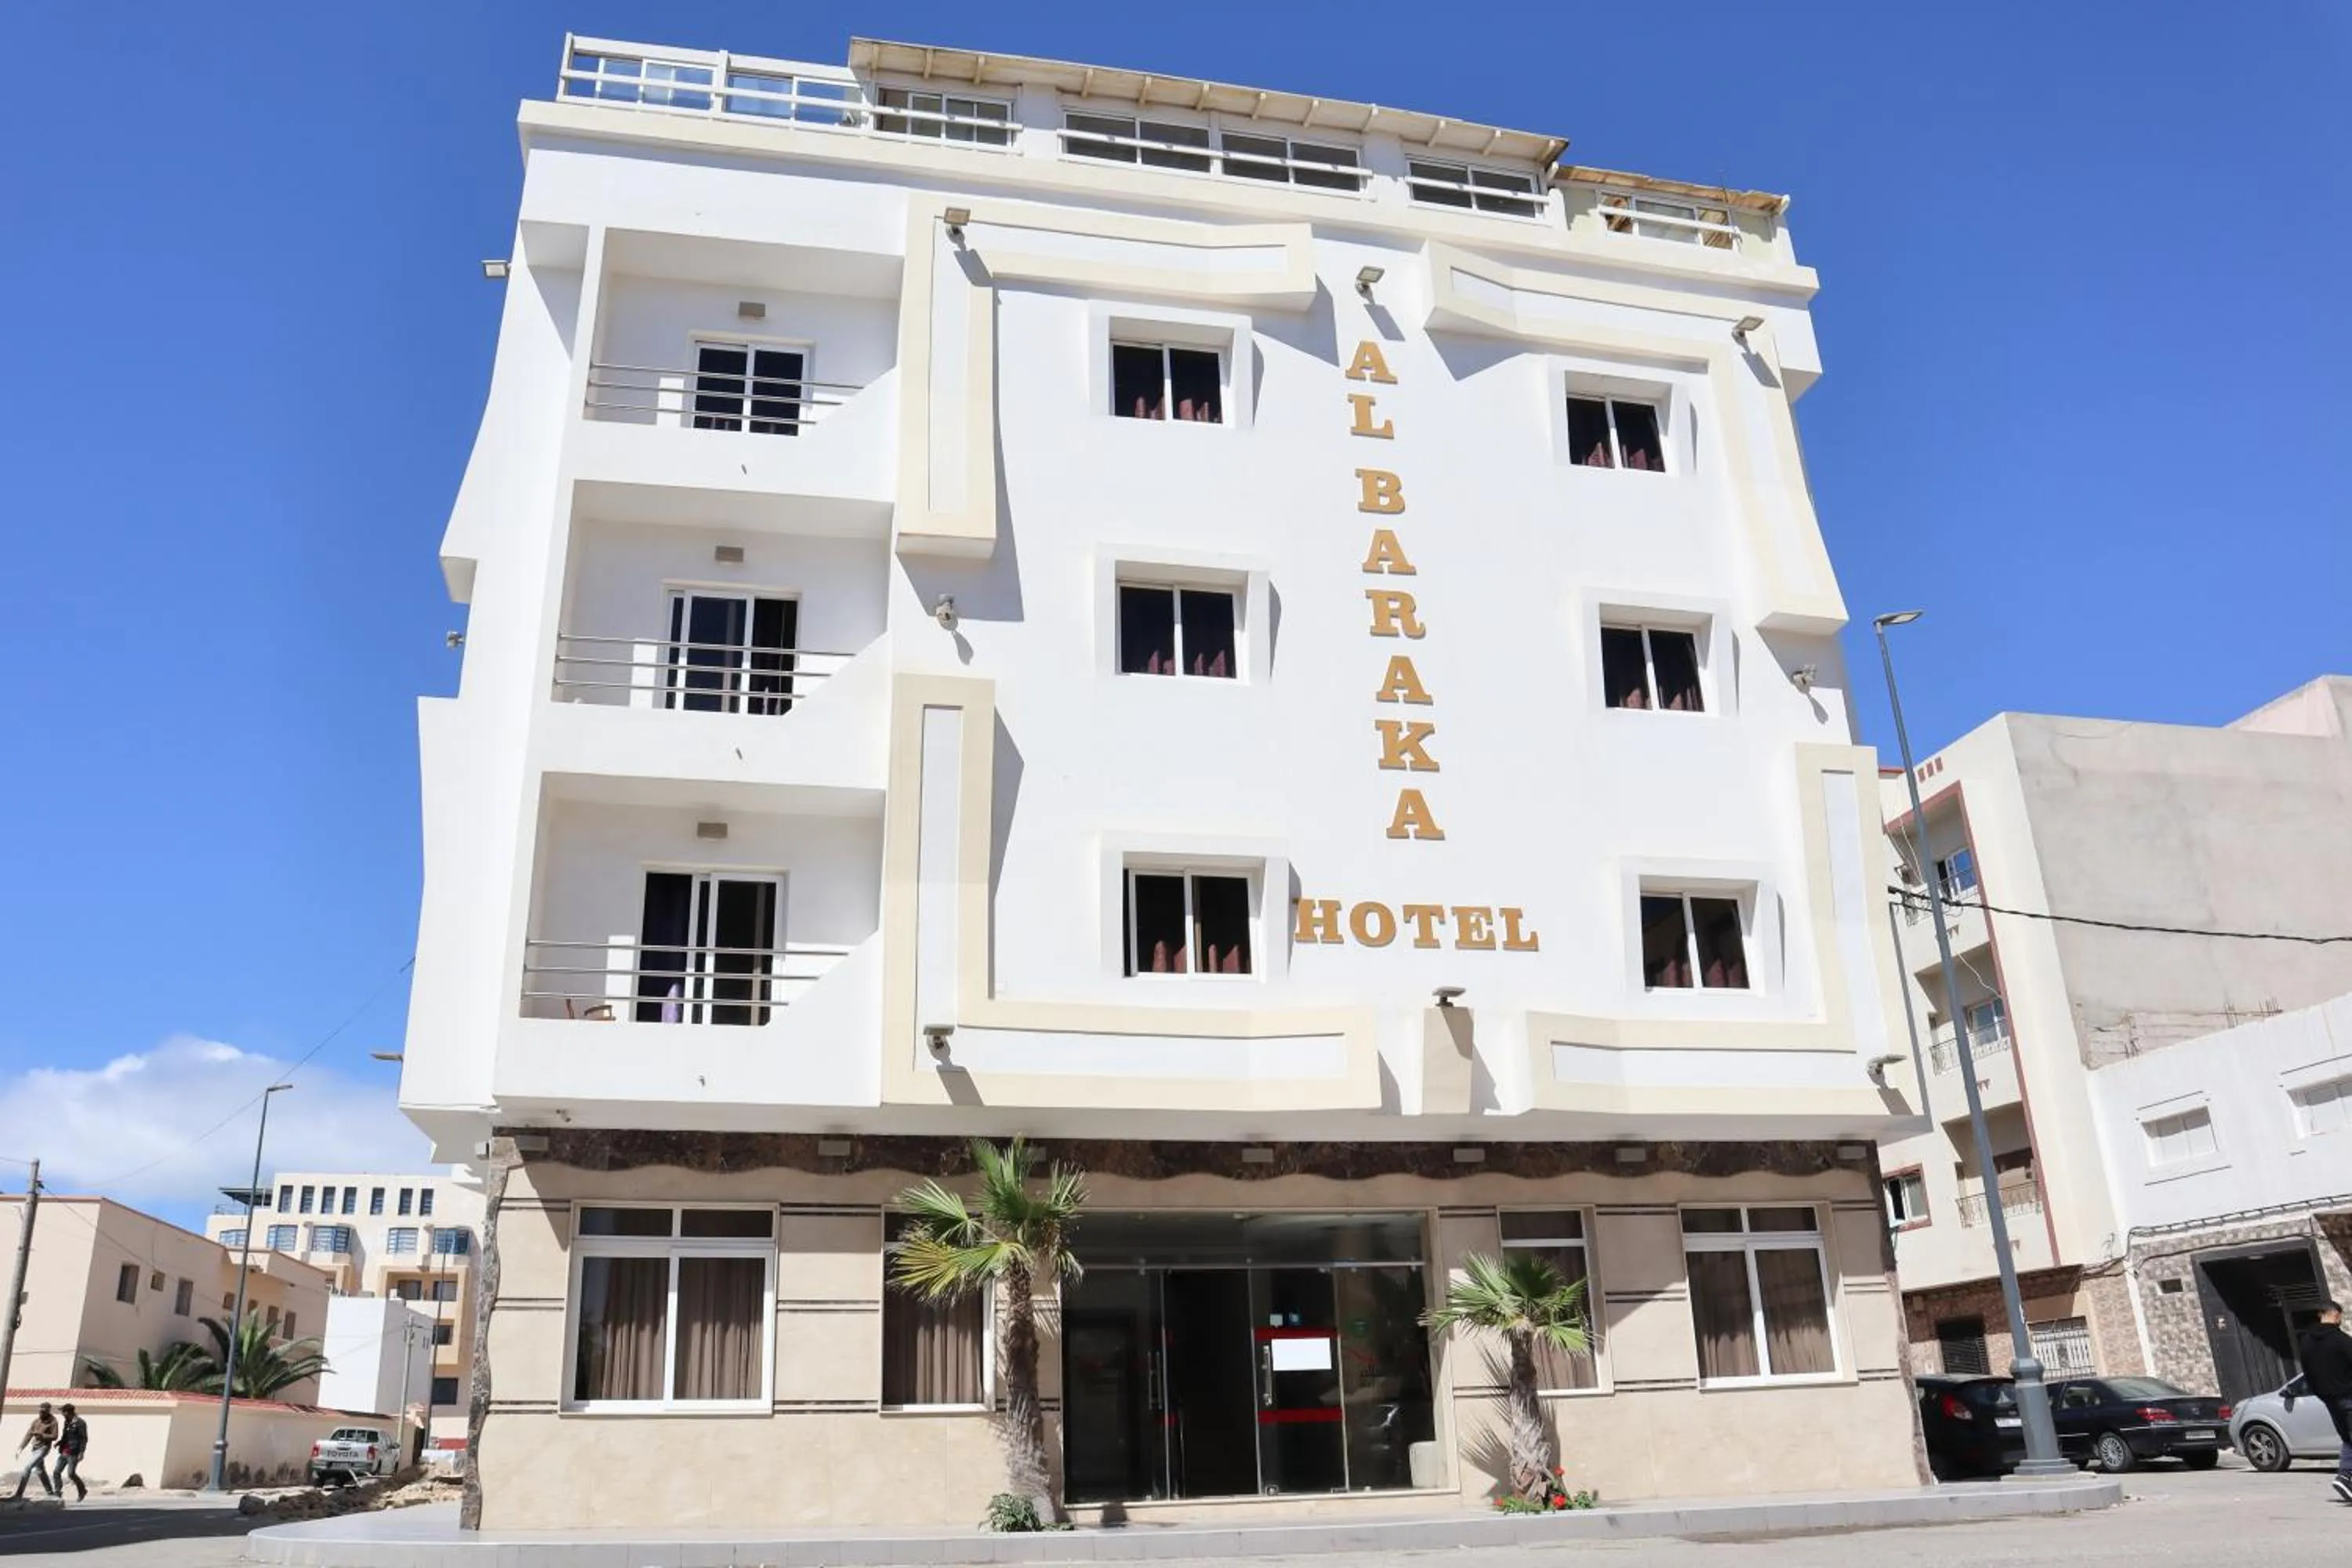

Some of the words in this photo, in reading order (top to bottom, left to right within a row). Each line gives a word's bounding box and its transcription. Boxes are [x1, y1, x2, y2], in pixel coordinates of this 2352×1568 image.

[1345, 340, 1398, 439] AL
[1355, 468, 1445, 840] BARAKA
[1292, 897, 1538, 952] HOTEL
